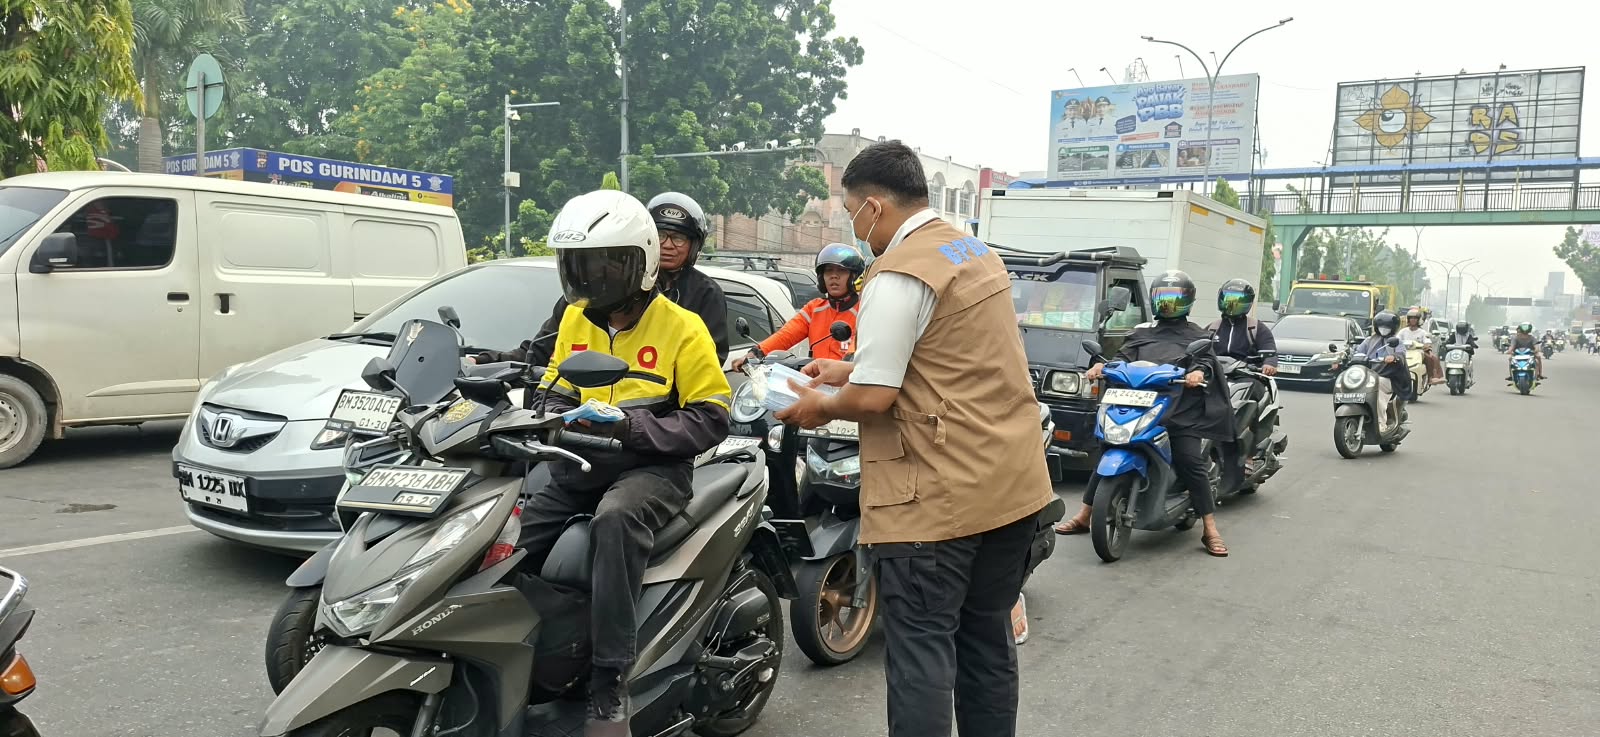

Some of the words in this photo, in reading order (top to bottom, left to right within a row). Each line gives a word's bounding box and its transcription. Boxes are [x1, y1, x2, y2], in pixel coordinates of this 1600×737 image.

[1136, 103, 1184, 123] PBB
[166, 159, 181, 174] POS
[181, 154, 222, 171] GURDAM
[223, 154, 230, 168] 5
[278, 157, 314, 175] POS
[319, 162, 408, 186] GURINDAM
[411, 175, 422, 188] 5
[1007, 271, 1049, 281] ACK
